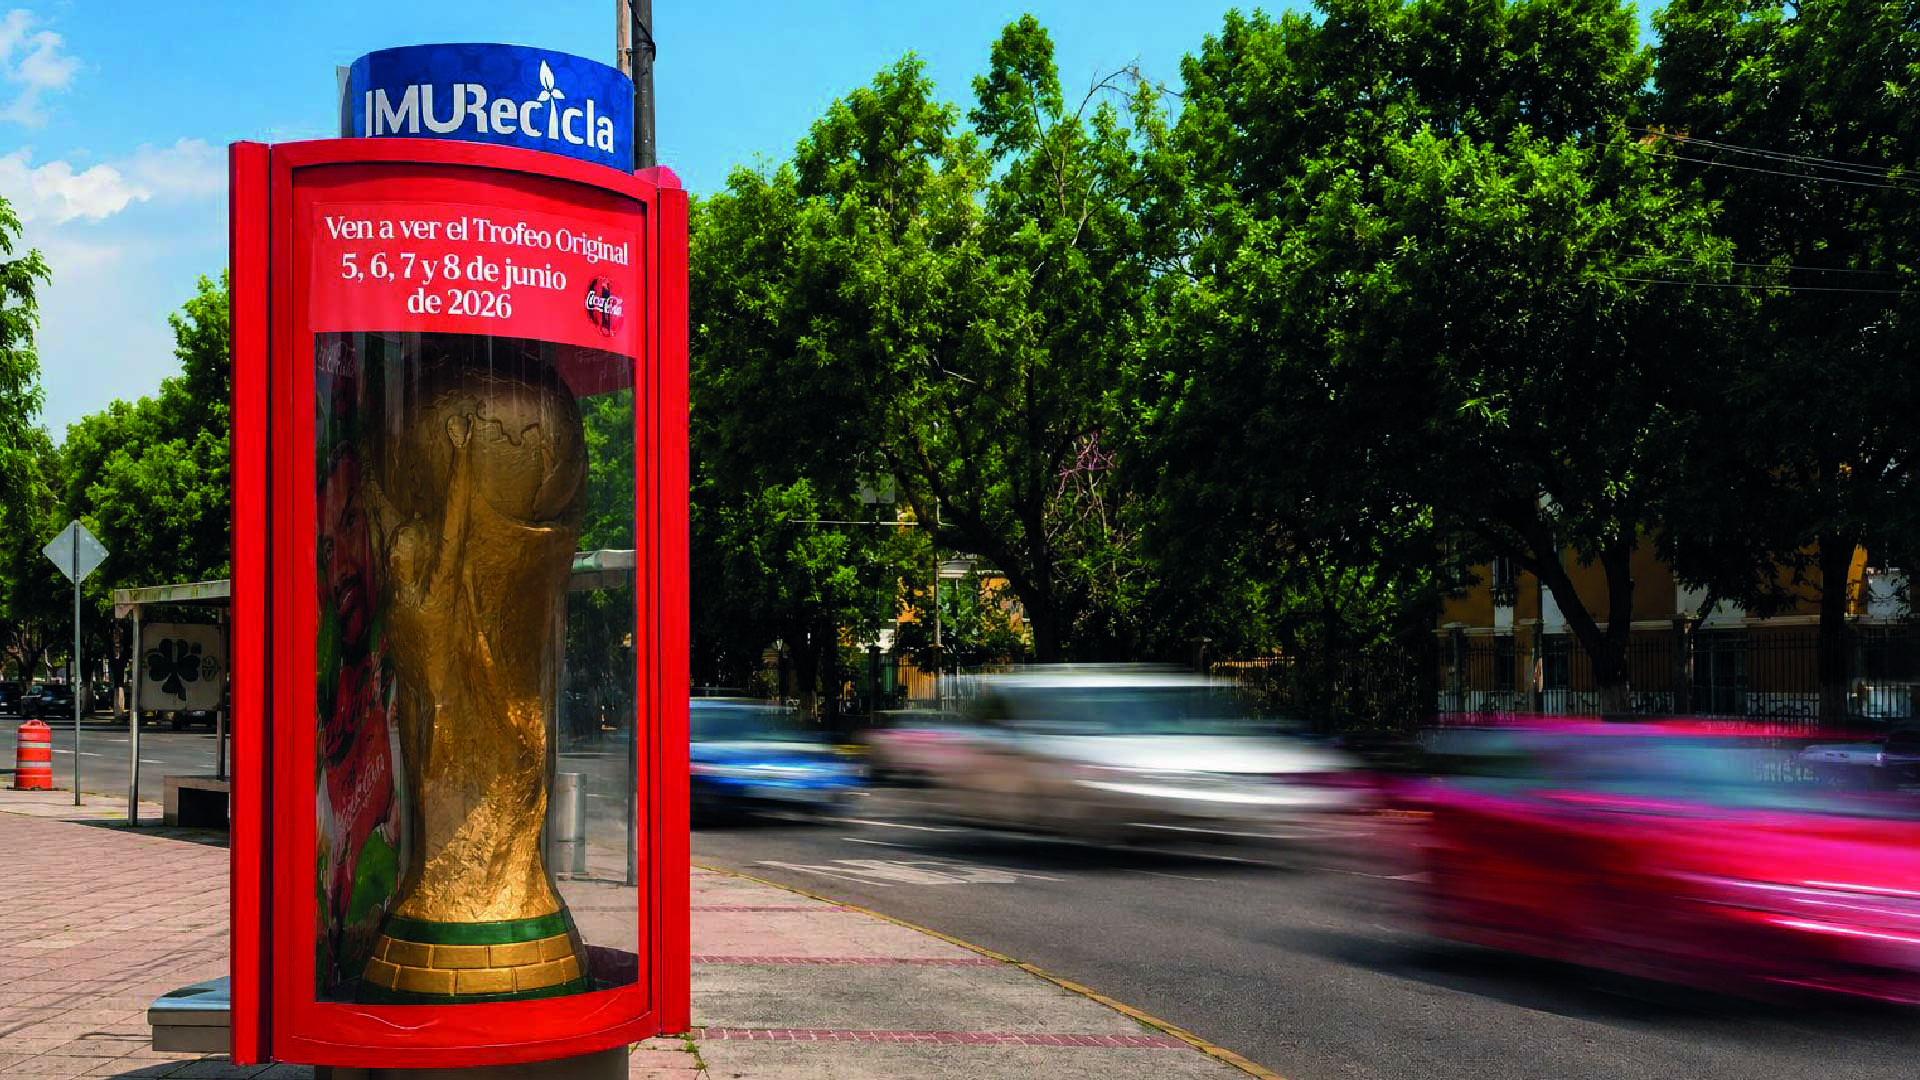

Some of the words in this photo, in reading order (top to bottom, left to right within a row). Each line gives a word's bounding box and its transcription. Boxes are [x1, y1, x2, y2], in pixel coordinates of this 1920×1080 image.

[366, 60, 614, 153] IMURecicla
[326, 217, 373, 239] Ven
[380, 221, 394, 239] a
[400, 221, 440, 239] ver
[447, 217, 467, 240] el
[473, 218, 551, 249] Trofeo
[556, 230, 628, 265] Original
[342, 254, 363, 281] 5,
[371, 253, 394, 281] 6,
[401, 254, 415, 278] 7
[421, 261, 437, 284] y
[444, 254, 461, 279] 8
[467, 256, 498, 281] de
[502, 260, 566, 290] junio
[408, 288, 441, 313] de
[448, 288, 511, 318] 2026
